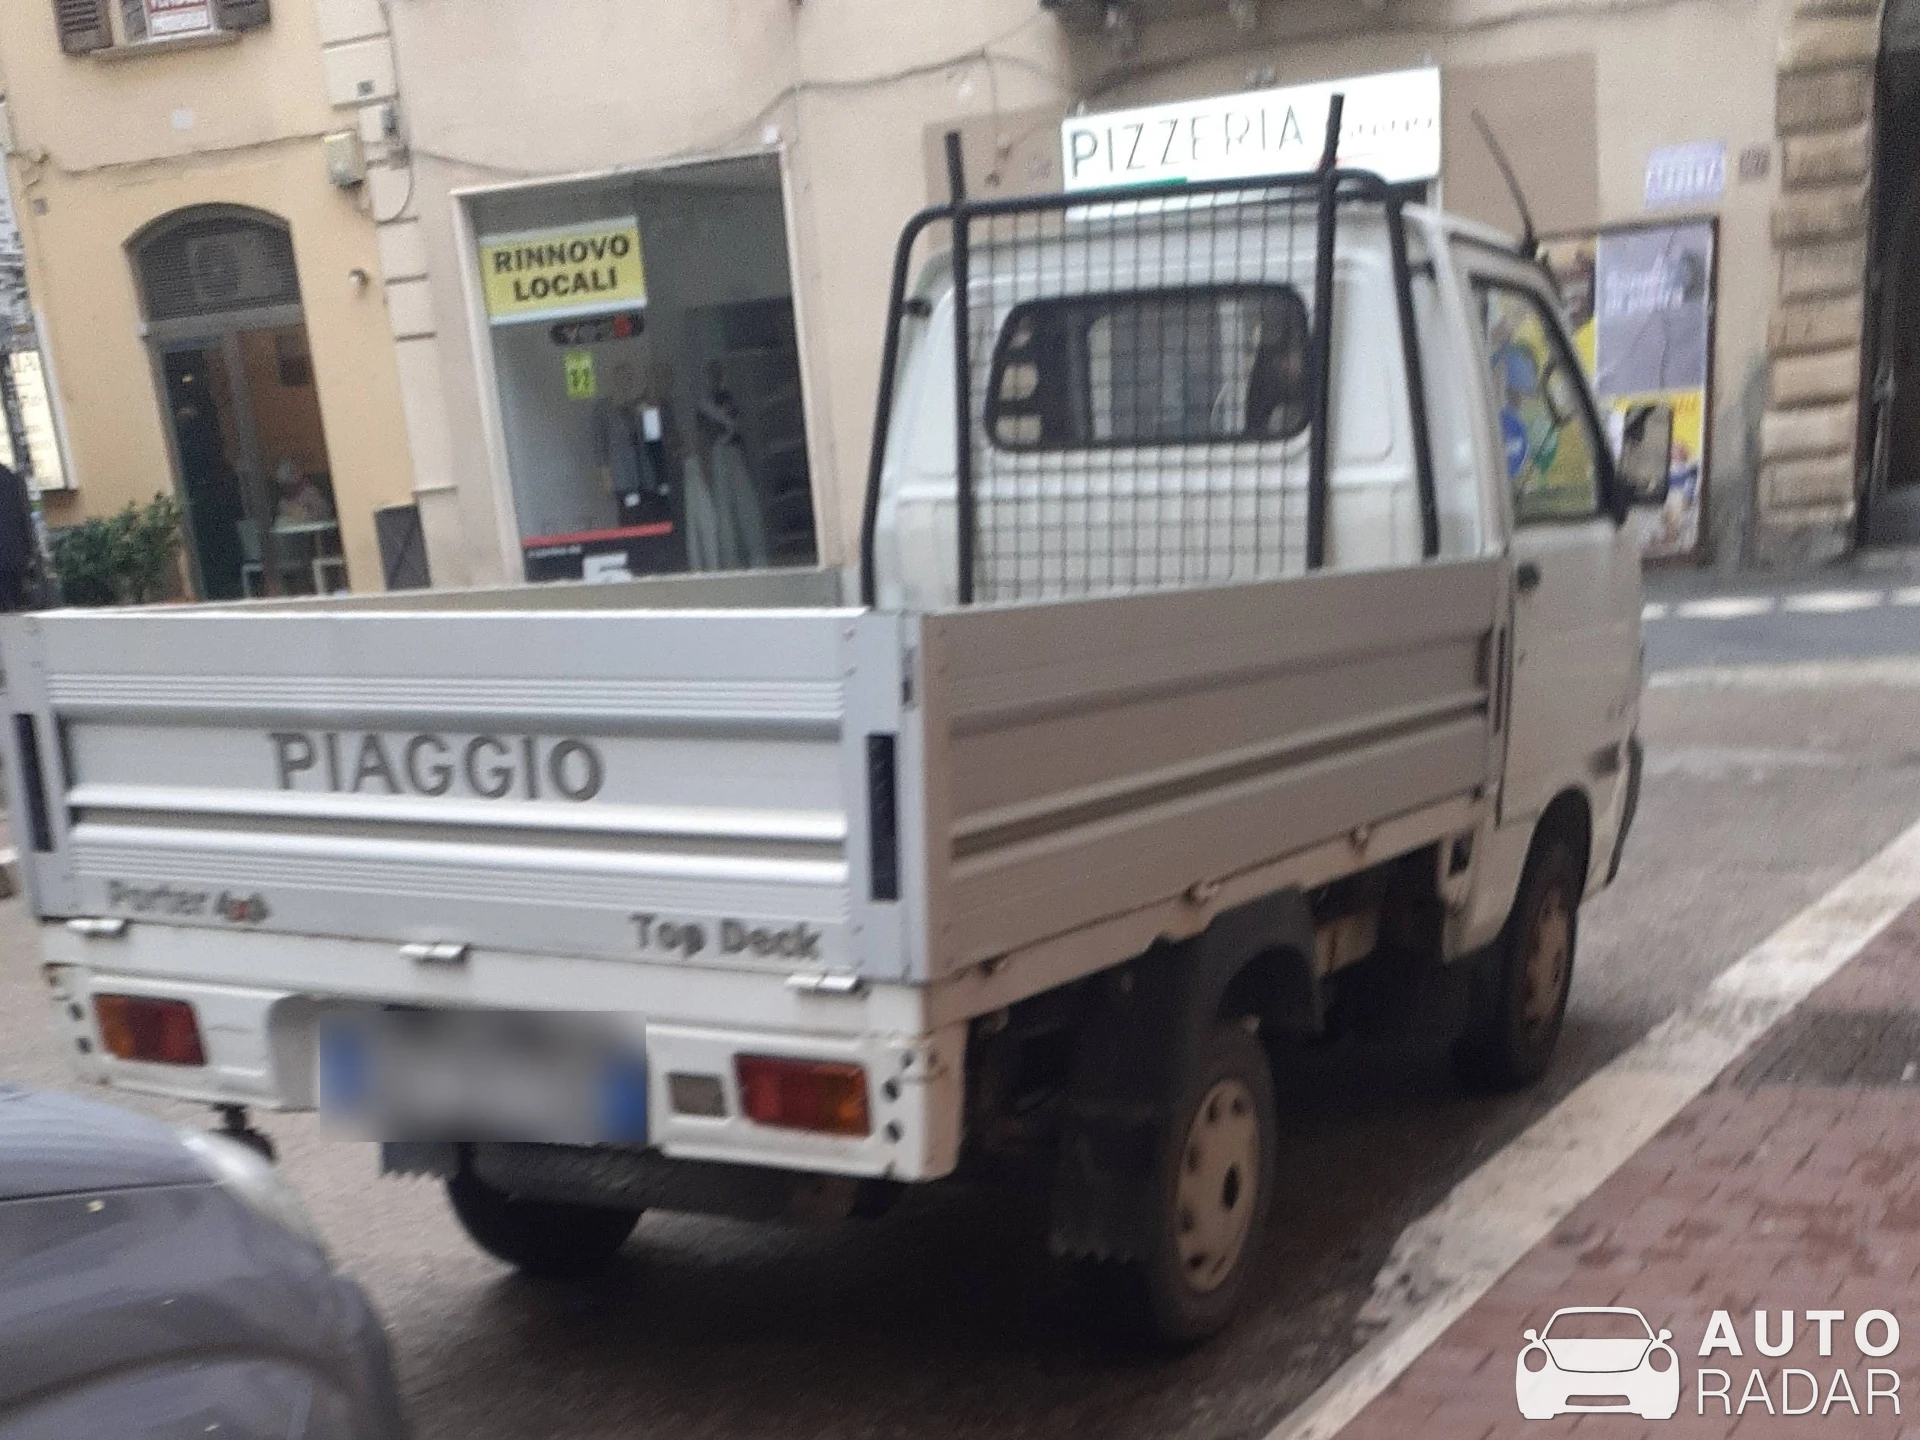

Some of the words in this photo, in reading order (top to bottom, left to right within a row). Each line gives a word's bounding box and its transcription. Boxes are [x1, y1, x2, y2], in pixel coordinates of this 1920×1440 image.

[1069, 103, 1304, 180] PIZZERIA
[492, 232, 630, 275] RINNOVO
[512, 266, 618, 302] LOCALI
[267, 730, 606, 803] PIAGGIO
[107, 879, 208, 917] Porter
[628, 911, 707, 958] Top
[718, 917, 822, 959] Deck
